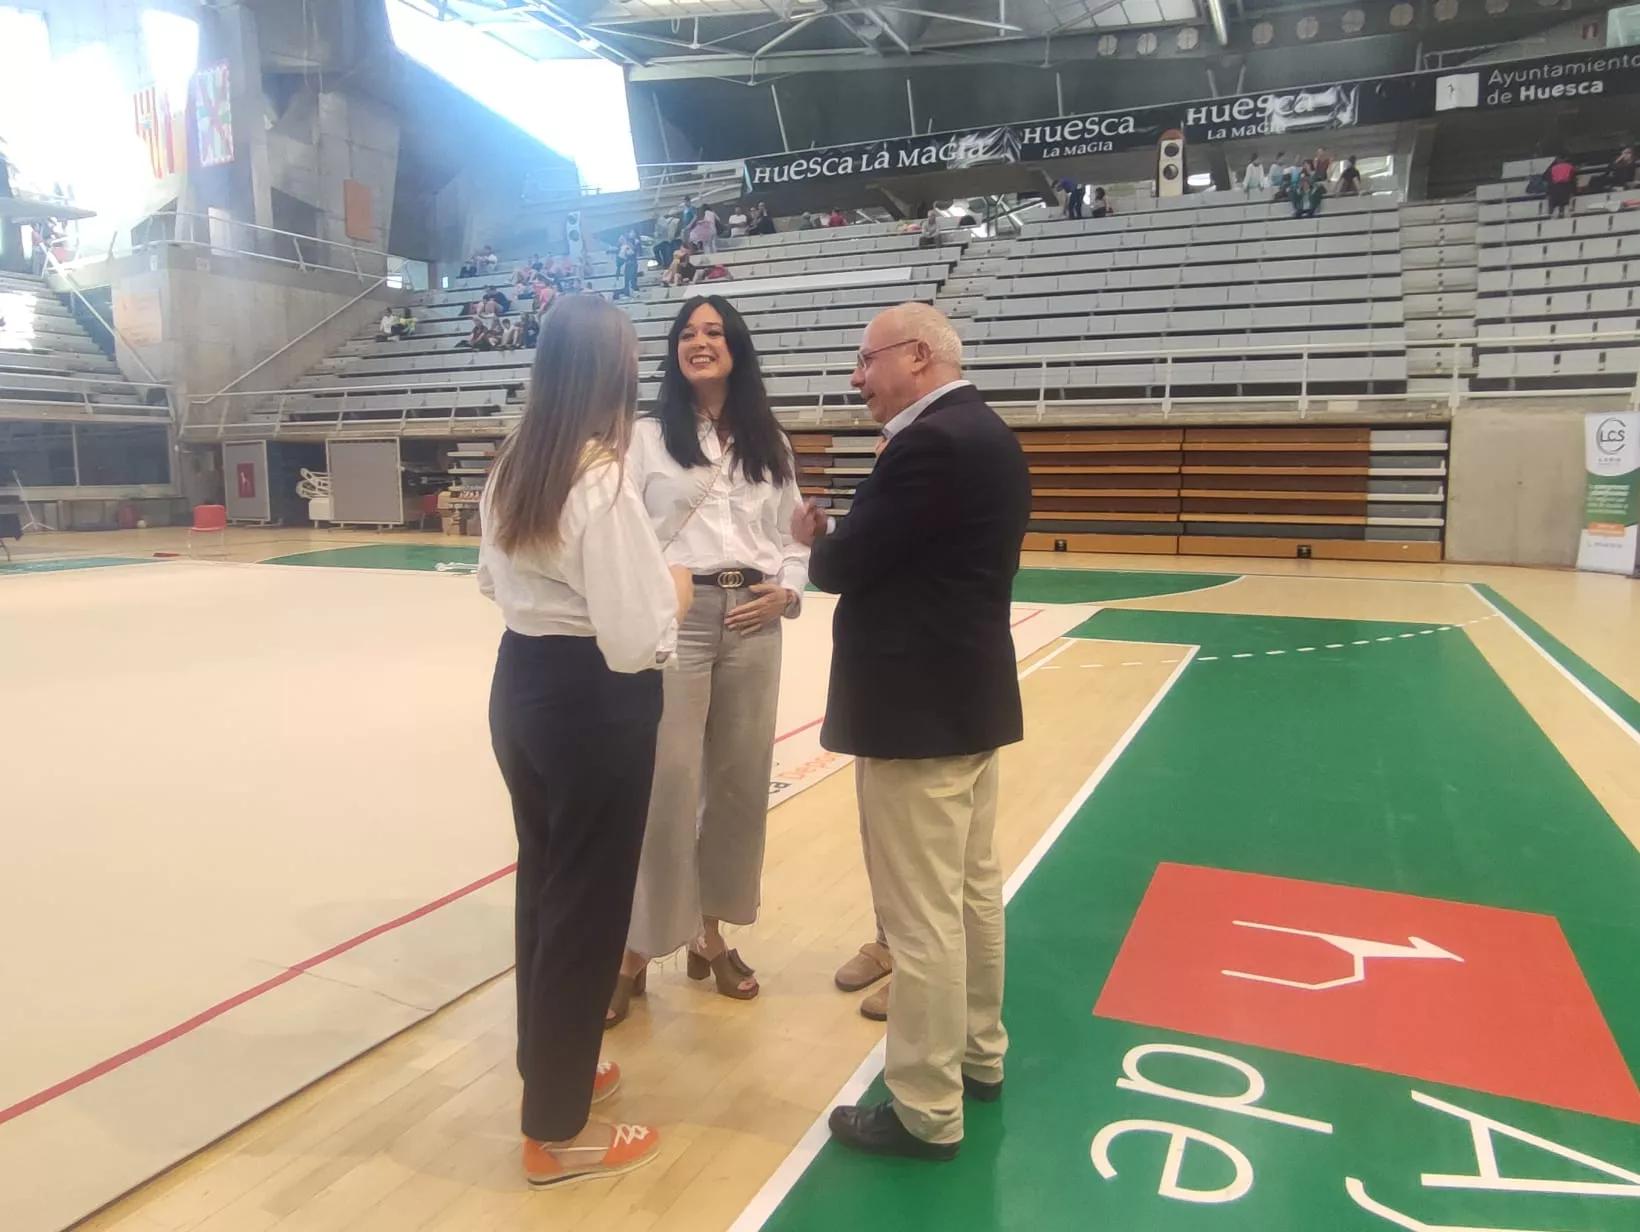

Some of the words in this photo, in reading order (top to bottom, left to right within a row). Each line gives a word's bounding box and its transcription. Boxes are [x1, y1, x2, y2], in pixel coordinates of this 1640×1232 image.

[1488, 54, 1640, 87] Ayuntamiento
[1487, 90, 1512, 105] de
[1520, 80, 1603, 101] Huesca
[1023, 115, 1135, 144] Huesca
[1208, 131, 1227, 140] La
[753, 156, 853, 183] Huesca
[860, 151, 890, 172] La
[1043, 149, 1060, 158] La
[1090, 1043, 1333, 1204] de
